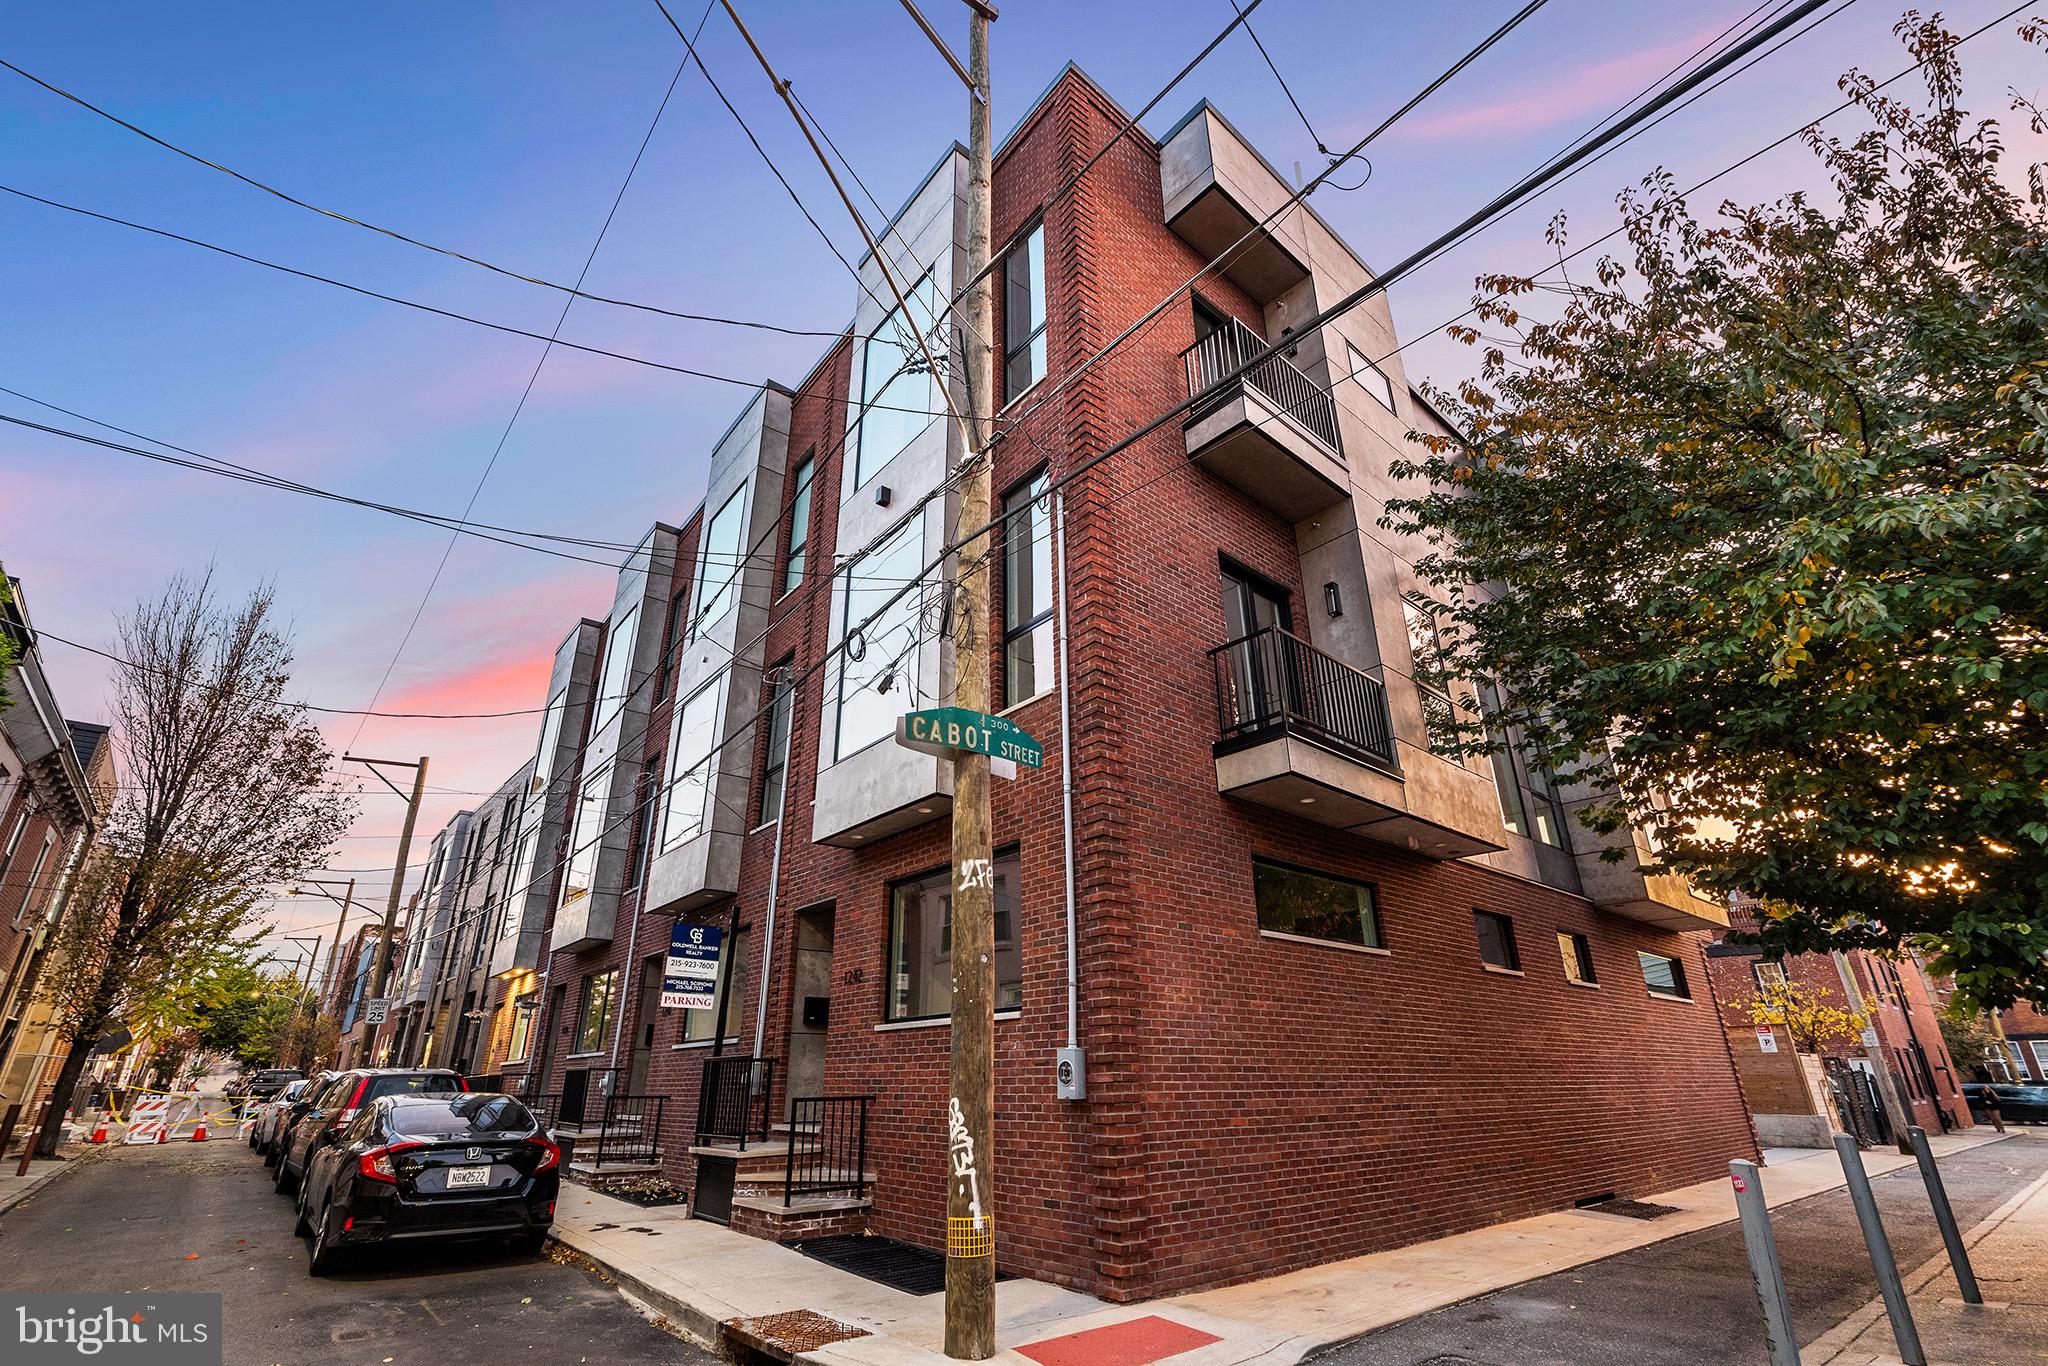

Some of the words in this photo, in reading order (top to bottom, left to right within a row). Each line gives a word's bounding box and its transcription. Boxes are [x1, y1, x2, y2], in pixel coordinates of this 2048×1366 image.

[990, 719, 1009, 731] 300
[912, 716, 992, 752] CABOT
[1001, 740, 1040, 766] STREET
[671, 942, 697, 950] COLDWELL
[670, 960, 715, 969] 215-923-7600
[664, 995, 712, 1007] PARKING
[368, 1012, 384, 1021] 25
[452, 1171, 486, 1183] NBW2522
